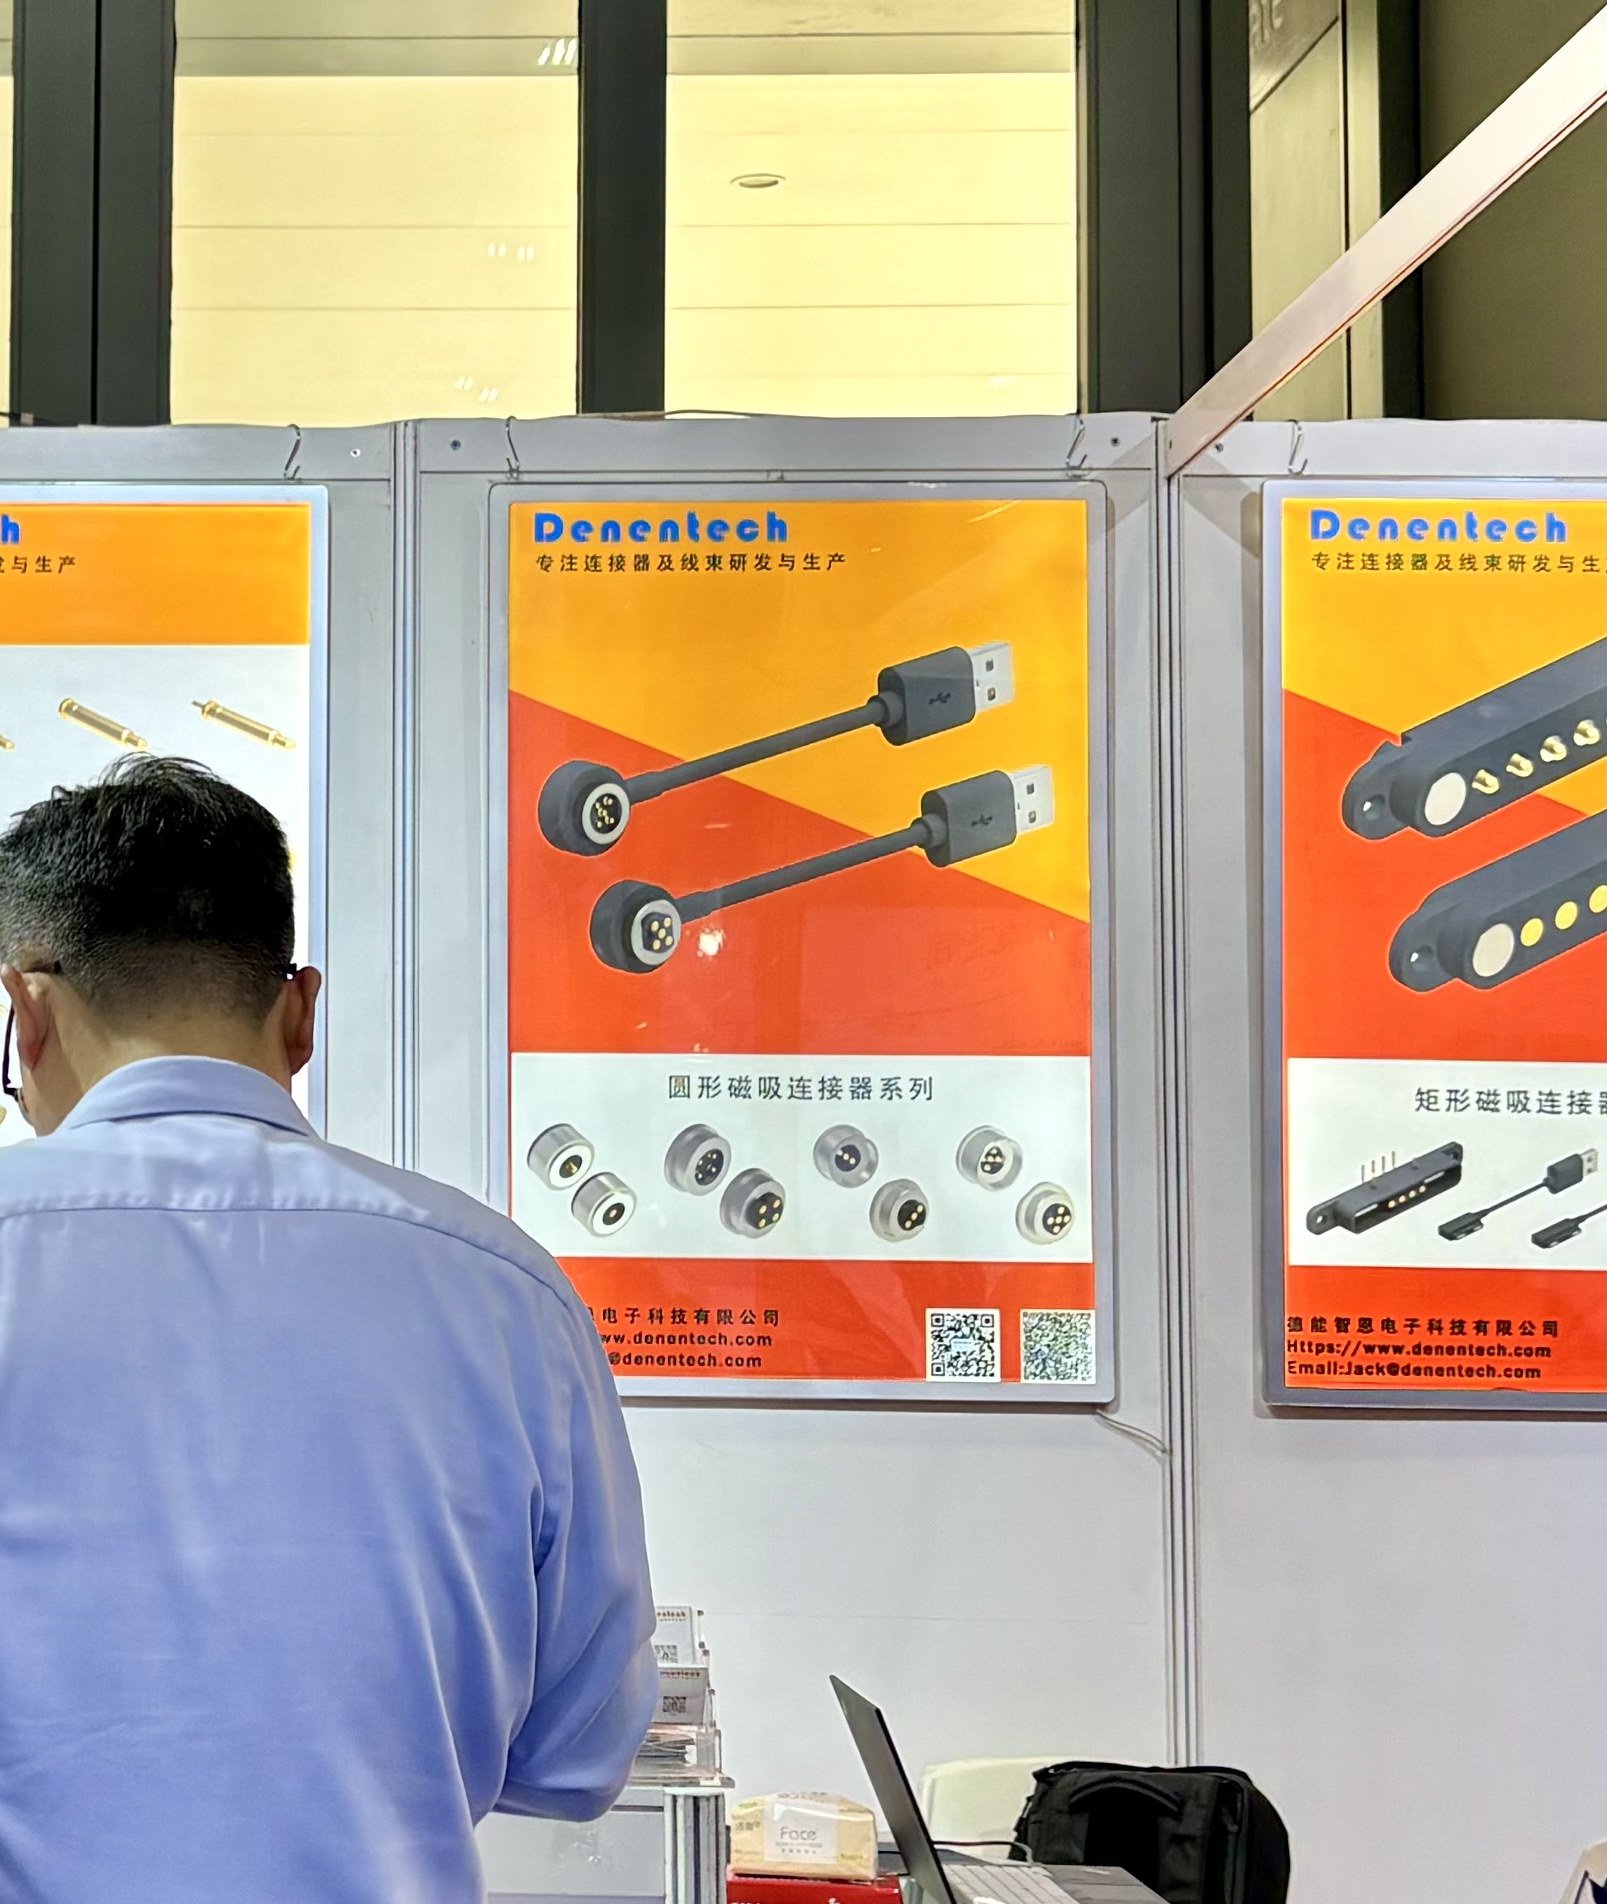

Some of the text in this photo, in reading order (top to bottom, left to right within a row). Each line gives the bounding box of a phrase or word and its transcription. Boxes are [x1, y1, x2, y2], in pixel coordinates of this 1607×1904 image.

[532, 510, 790, 544] Denentech
[1309, 508, 1568, 543] Denentech
[535, 552, 848, 574] 专注连接器及线束研发与生产
[1311, 552, 1607, 574] 专注连接器及线束研发与生
[667, 1074, 935, 1103] 圆形磁吸连接器系列
[1286, 1339, 1552, 1358] Https://www.denentech.com
[780, 1826, 818, 1842] Face
